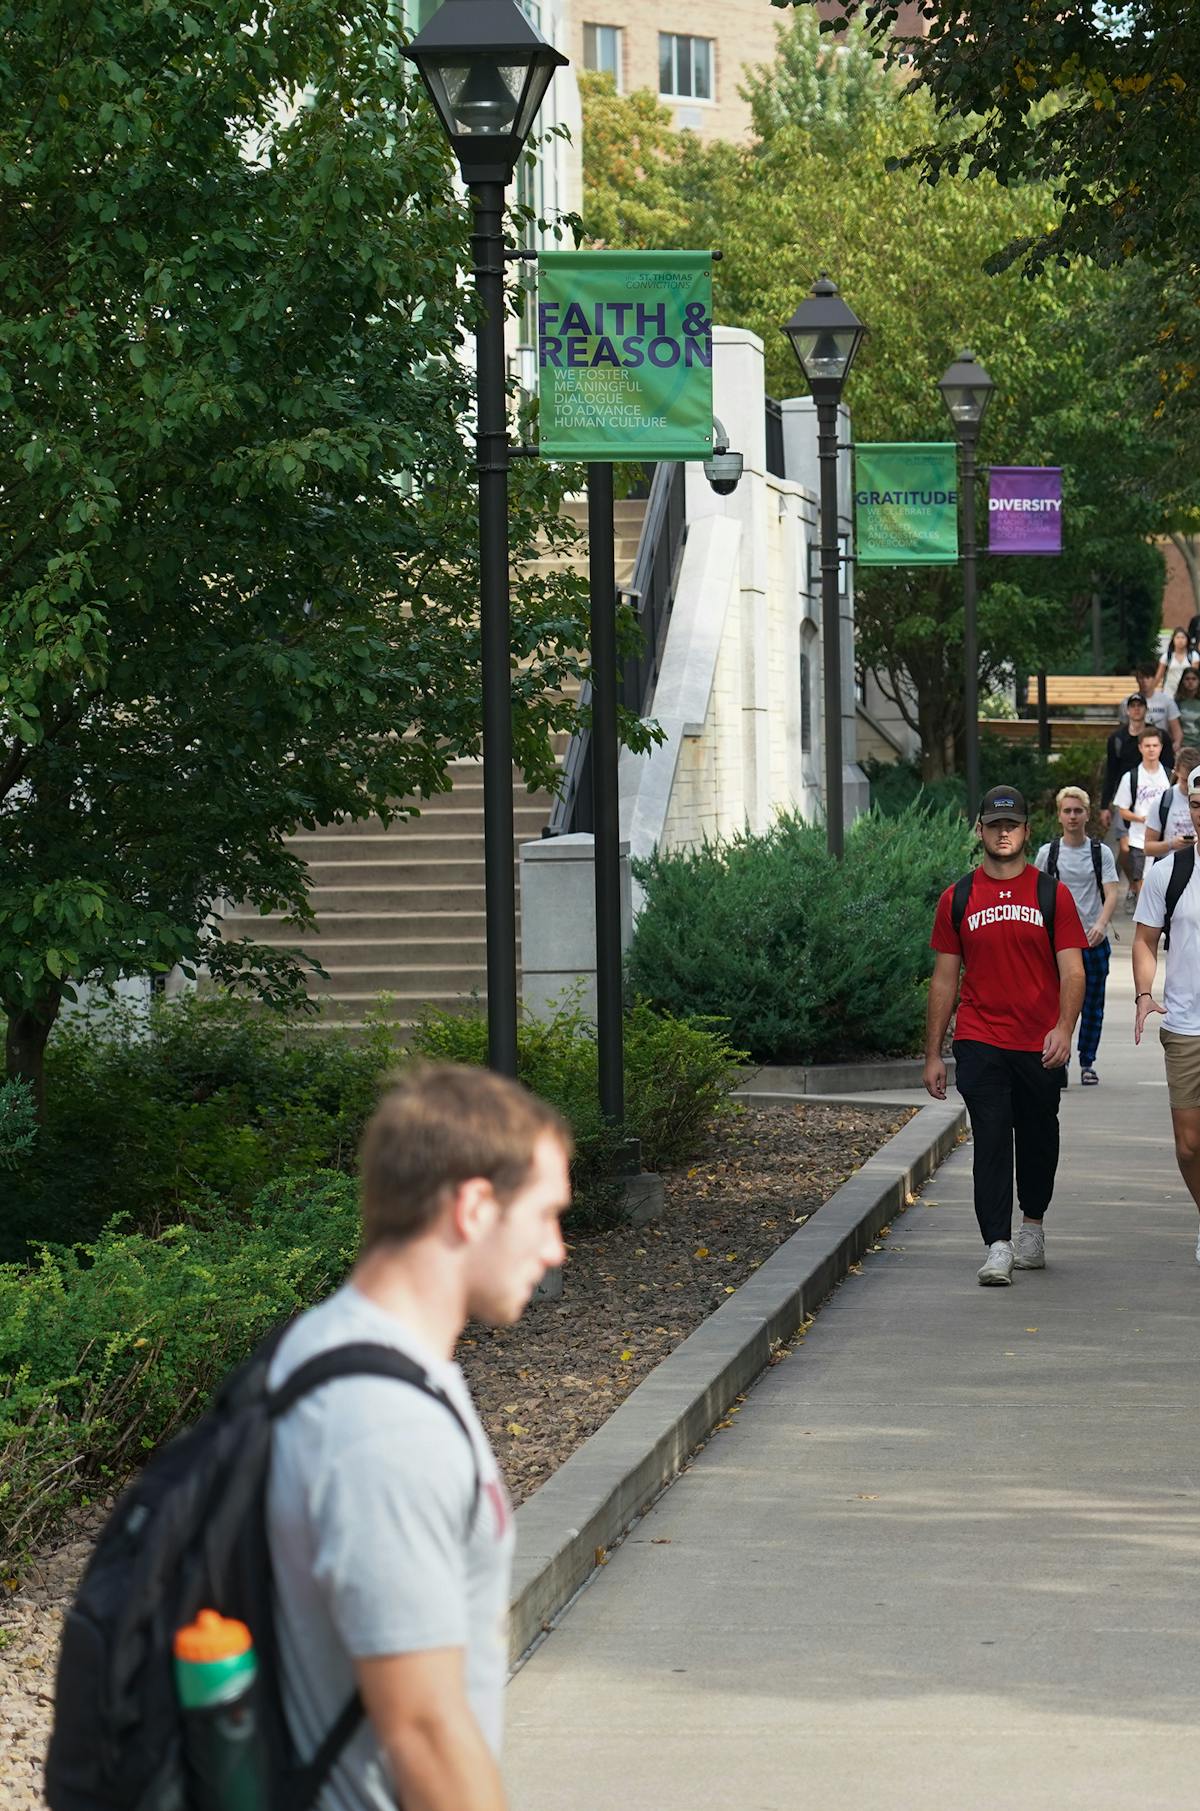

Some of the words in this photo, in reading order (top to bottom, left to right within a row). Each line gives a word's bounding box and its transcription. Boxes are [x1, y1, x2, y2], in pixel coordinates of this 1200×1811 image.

[653, 273, 693, 281] THOMAS
[625, 281, 691, 289] CONVICTIONS
[538, 303, 666, 336] FAITH
[682, 302, 713, 337] &
[538, 336, 713, 368] REASON
[554, 369, 575, 380] WE
[579, 369, 629, 380] FOSTER
[554, 381, 643, 392] MEANINGFUL
[554, 393, 623, 404] DIALOGUE
[554, 405, 573, 415] TO
[576, 405, 641, 415] ADVANCE
[554, 417, 605, 428] HUMAN
[609, 417, 667, 428] CULTURE
[856, 491, 957, 505] GRATITUDE
[989, 498, 1062, 511] DIVERSITY
[867, 507, 880, 516] WE
[967, 904, 1044, 931] WISCONSIN
